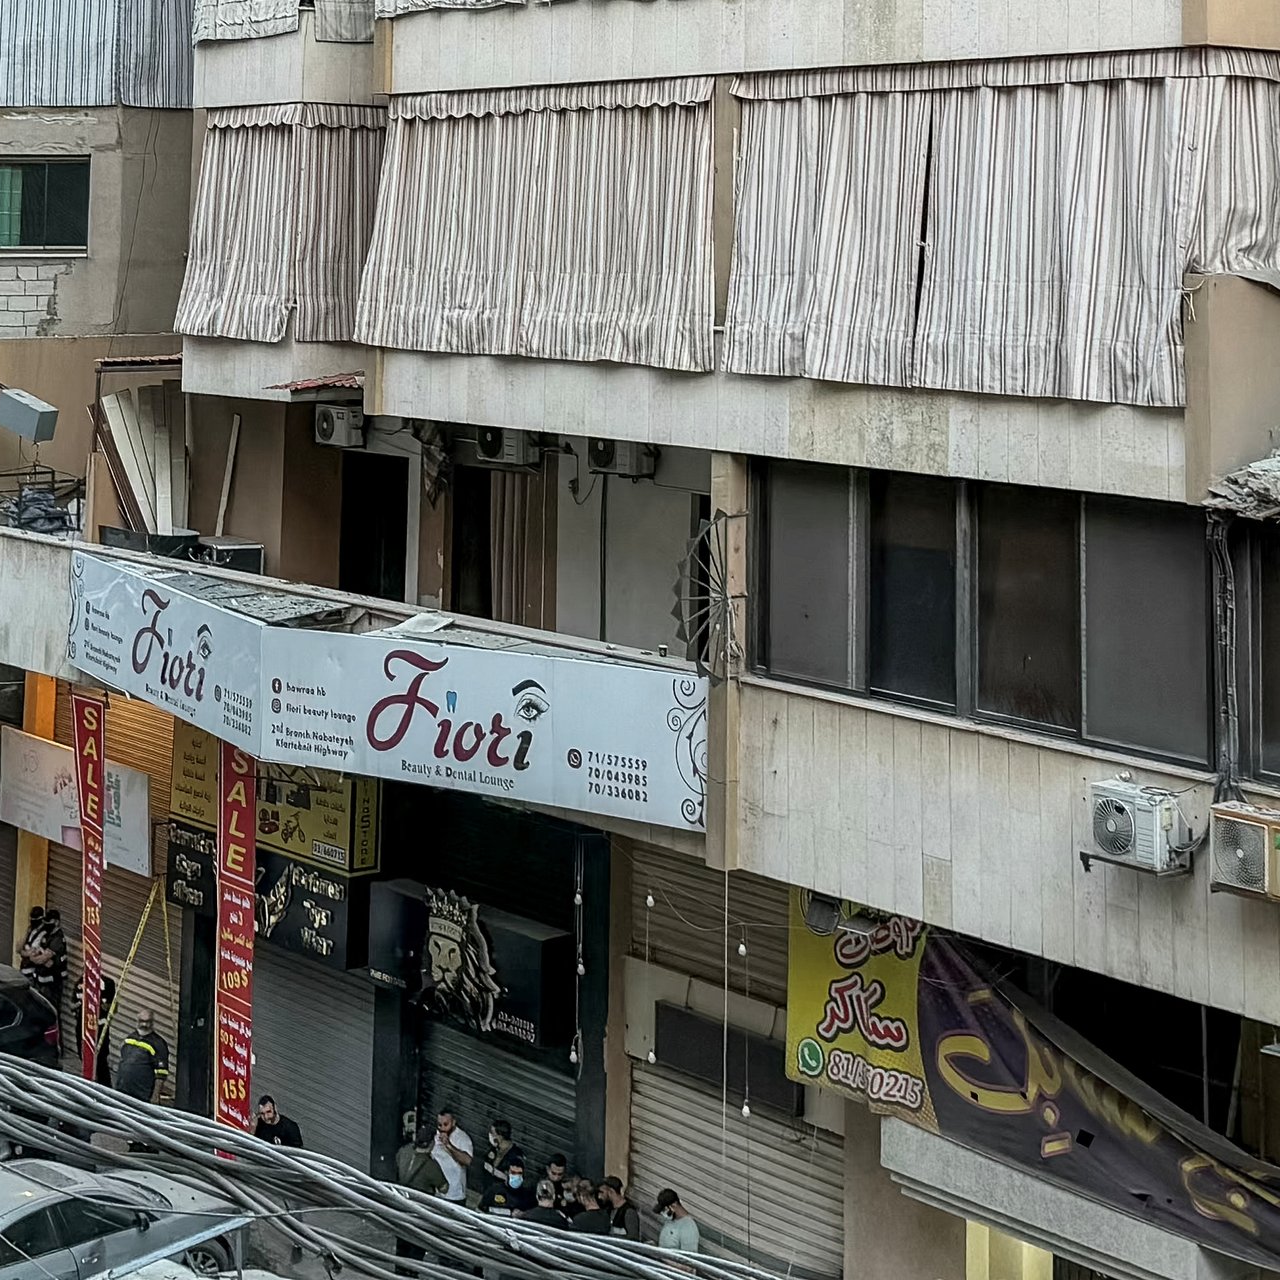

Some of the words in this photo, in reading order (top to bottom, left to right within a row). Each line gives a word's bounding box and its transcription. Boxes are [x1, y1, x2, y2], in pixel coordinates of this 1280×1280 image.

[132, 588, 206, 702] Fiori
[367, 650, 532, 770] Fiori
[83, 707, 99, 818] SALE
[313, 744, 348, 760] Highway
[587, 751, 648, 771] 71/575559
[401, 759, 433, 777] Beauty
[435, 765, 442, 776] &
[445, 766, 476, 782] Dental
[479, 772, 515, 790] Lounge
[587, 767, 648, 787] 70/043985
[587, 782, 648, 802] 70/336082
[227, 748, 249, 872] SALE
[222, 969, 249, 989] 109$
[223, 1079, 246, 1100] 15$
